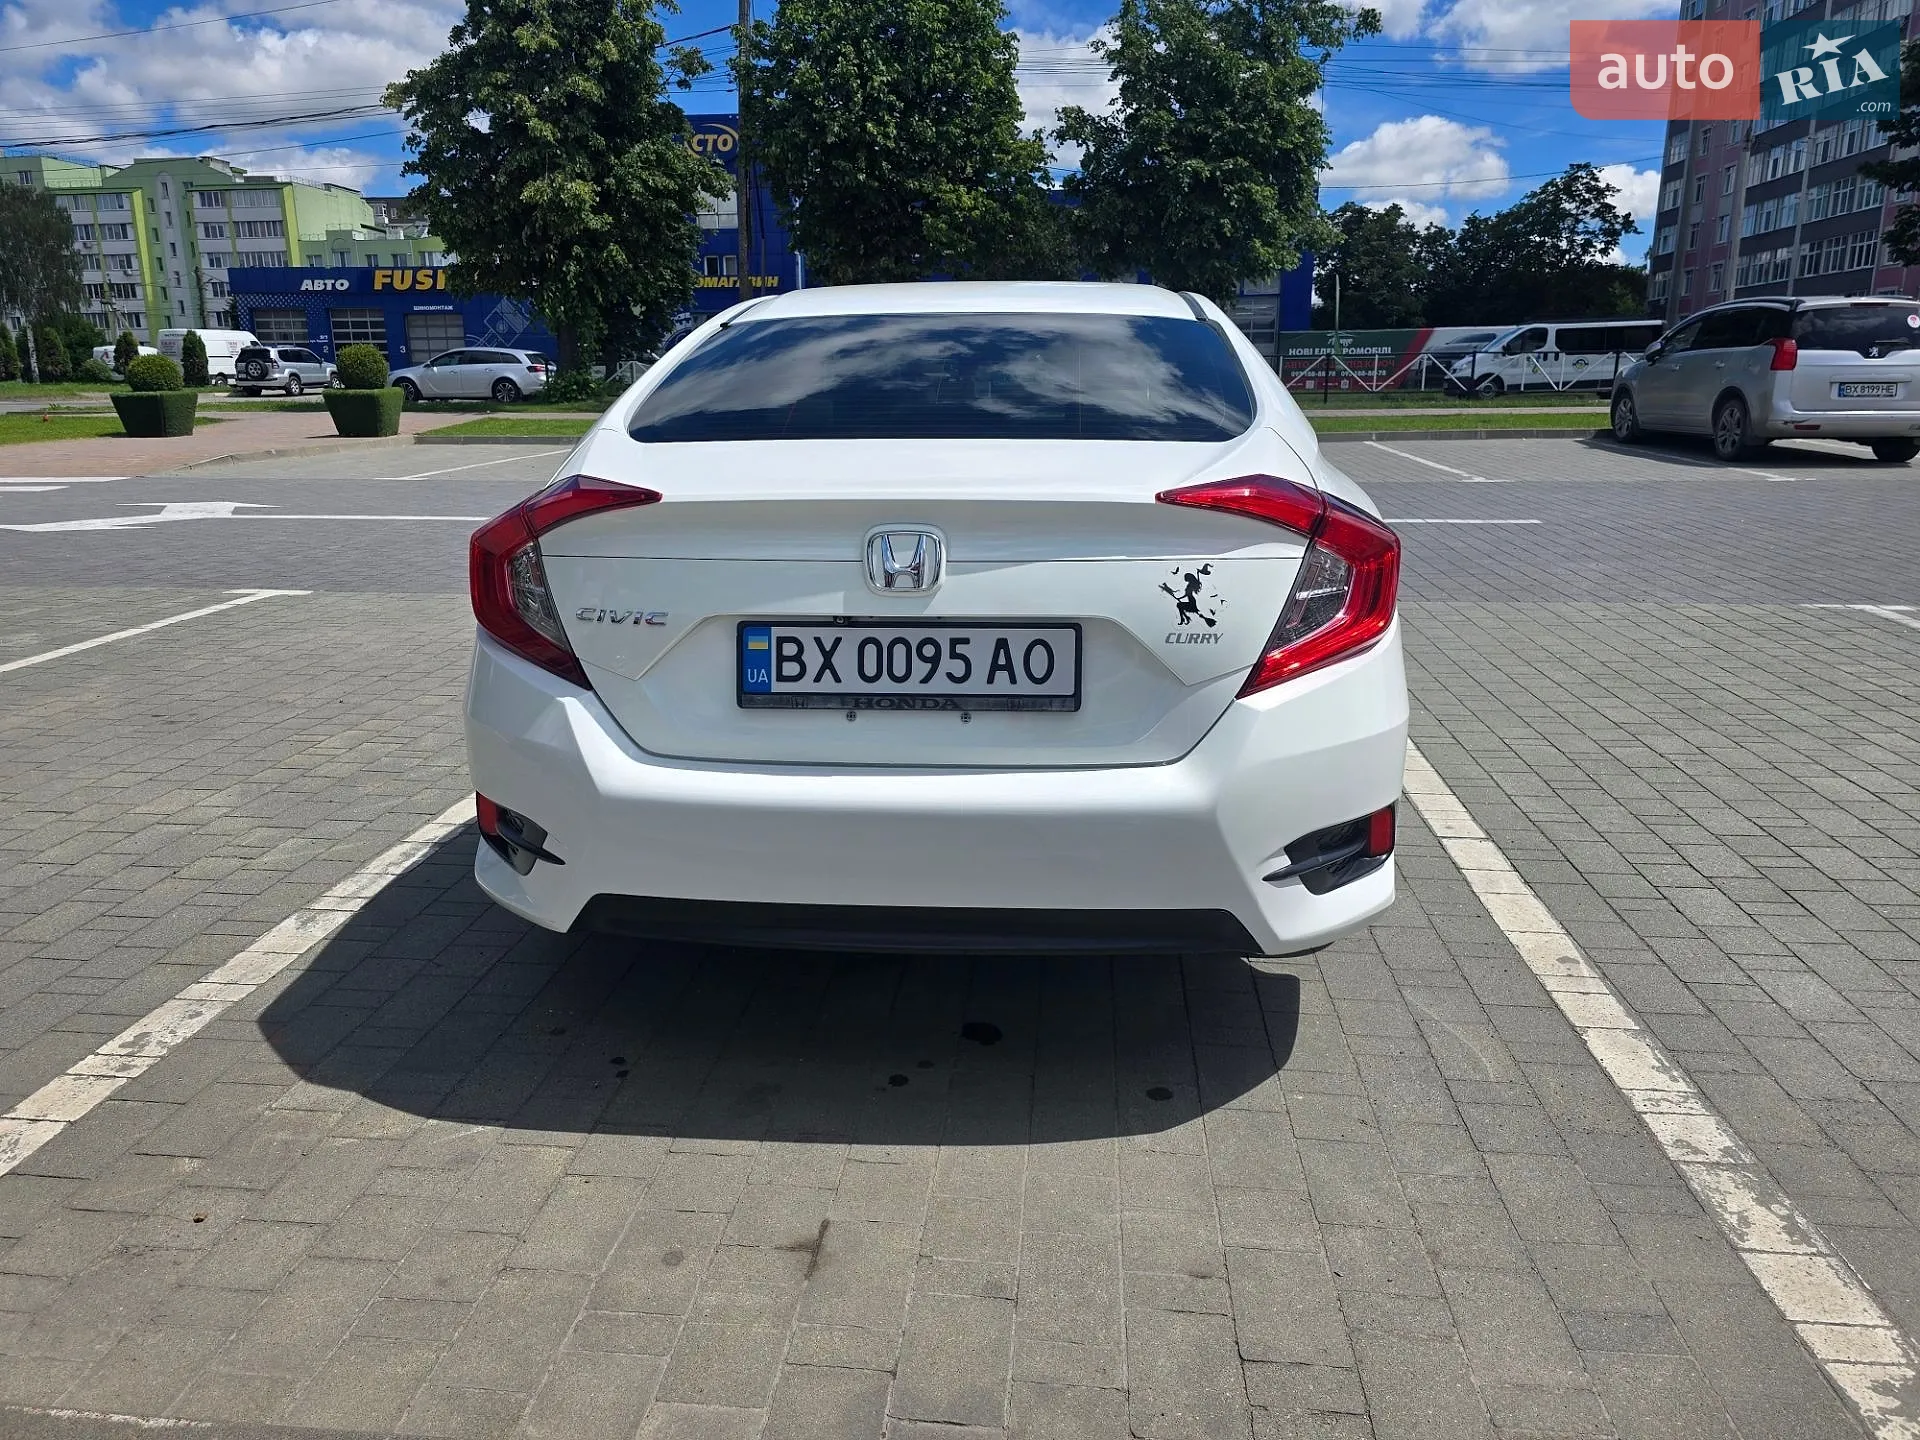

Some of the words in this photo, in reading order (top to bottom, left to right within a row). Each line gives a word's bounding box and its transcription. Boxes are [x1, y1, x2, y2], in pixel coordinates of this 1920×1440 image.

[692, 134, 733, 152] СТО
[300, 279, 350, 291] АВТО
[373, 269, 446, 291] FUSI
[694, 276, 779, 288] ОМАГЗИН
[323, 345, 329, 353] 2
[400, 345, 406, 353] 3
[1288, 347, 1313, 356] НОВІ
[1845, 385, 1860, 394] BX
[1860, 385, 1881, 394] 8199
[1881, 385, 1895, 394] HE
[575, 607, 669, 626] CIVIC
[1165, 632, 1224, 645] CURRY
[775, 636, 843, 684] BX
[857, 636, 972, 684] 0095
[986, 637, 1055, 685] AO
[747, 668, 769, 684] UA
[852, 696, 965, 710] HONDA
